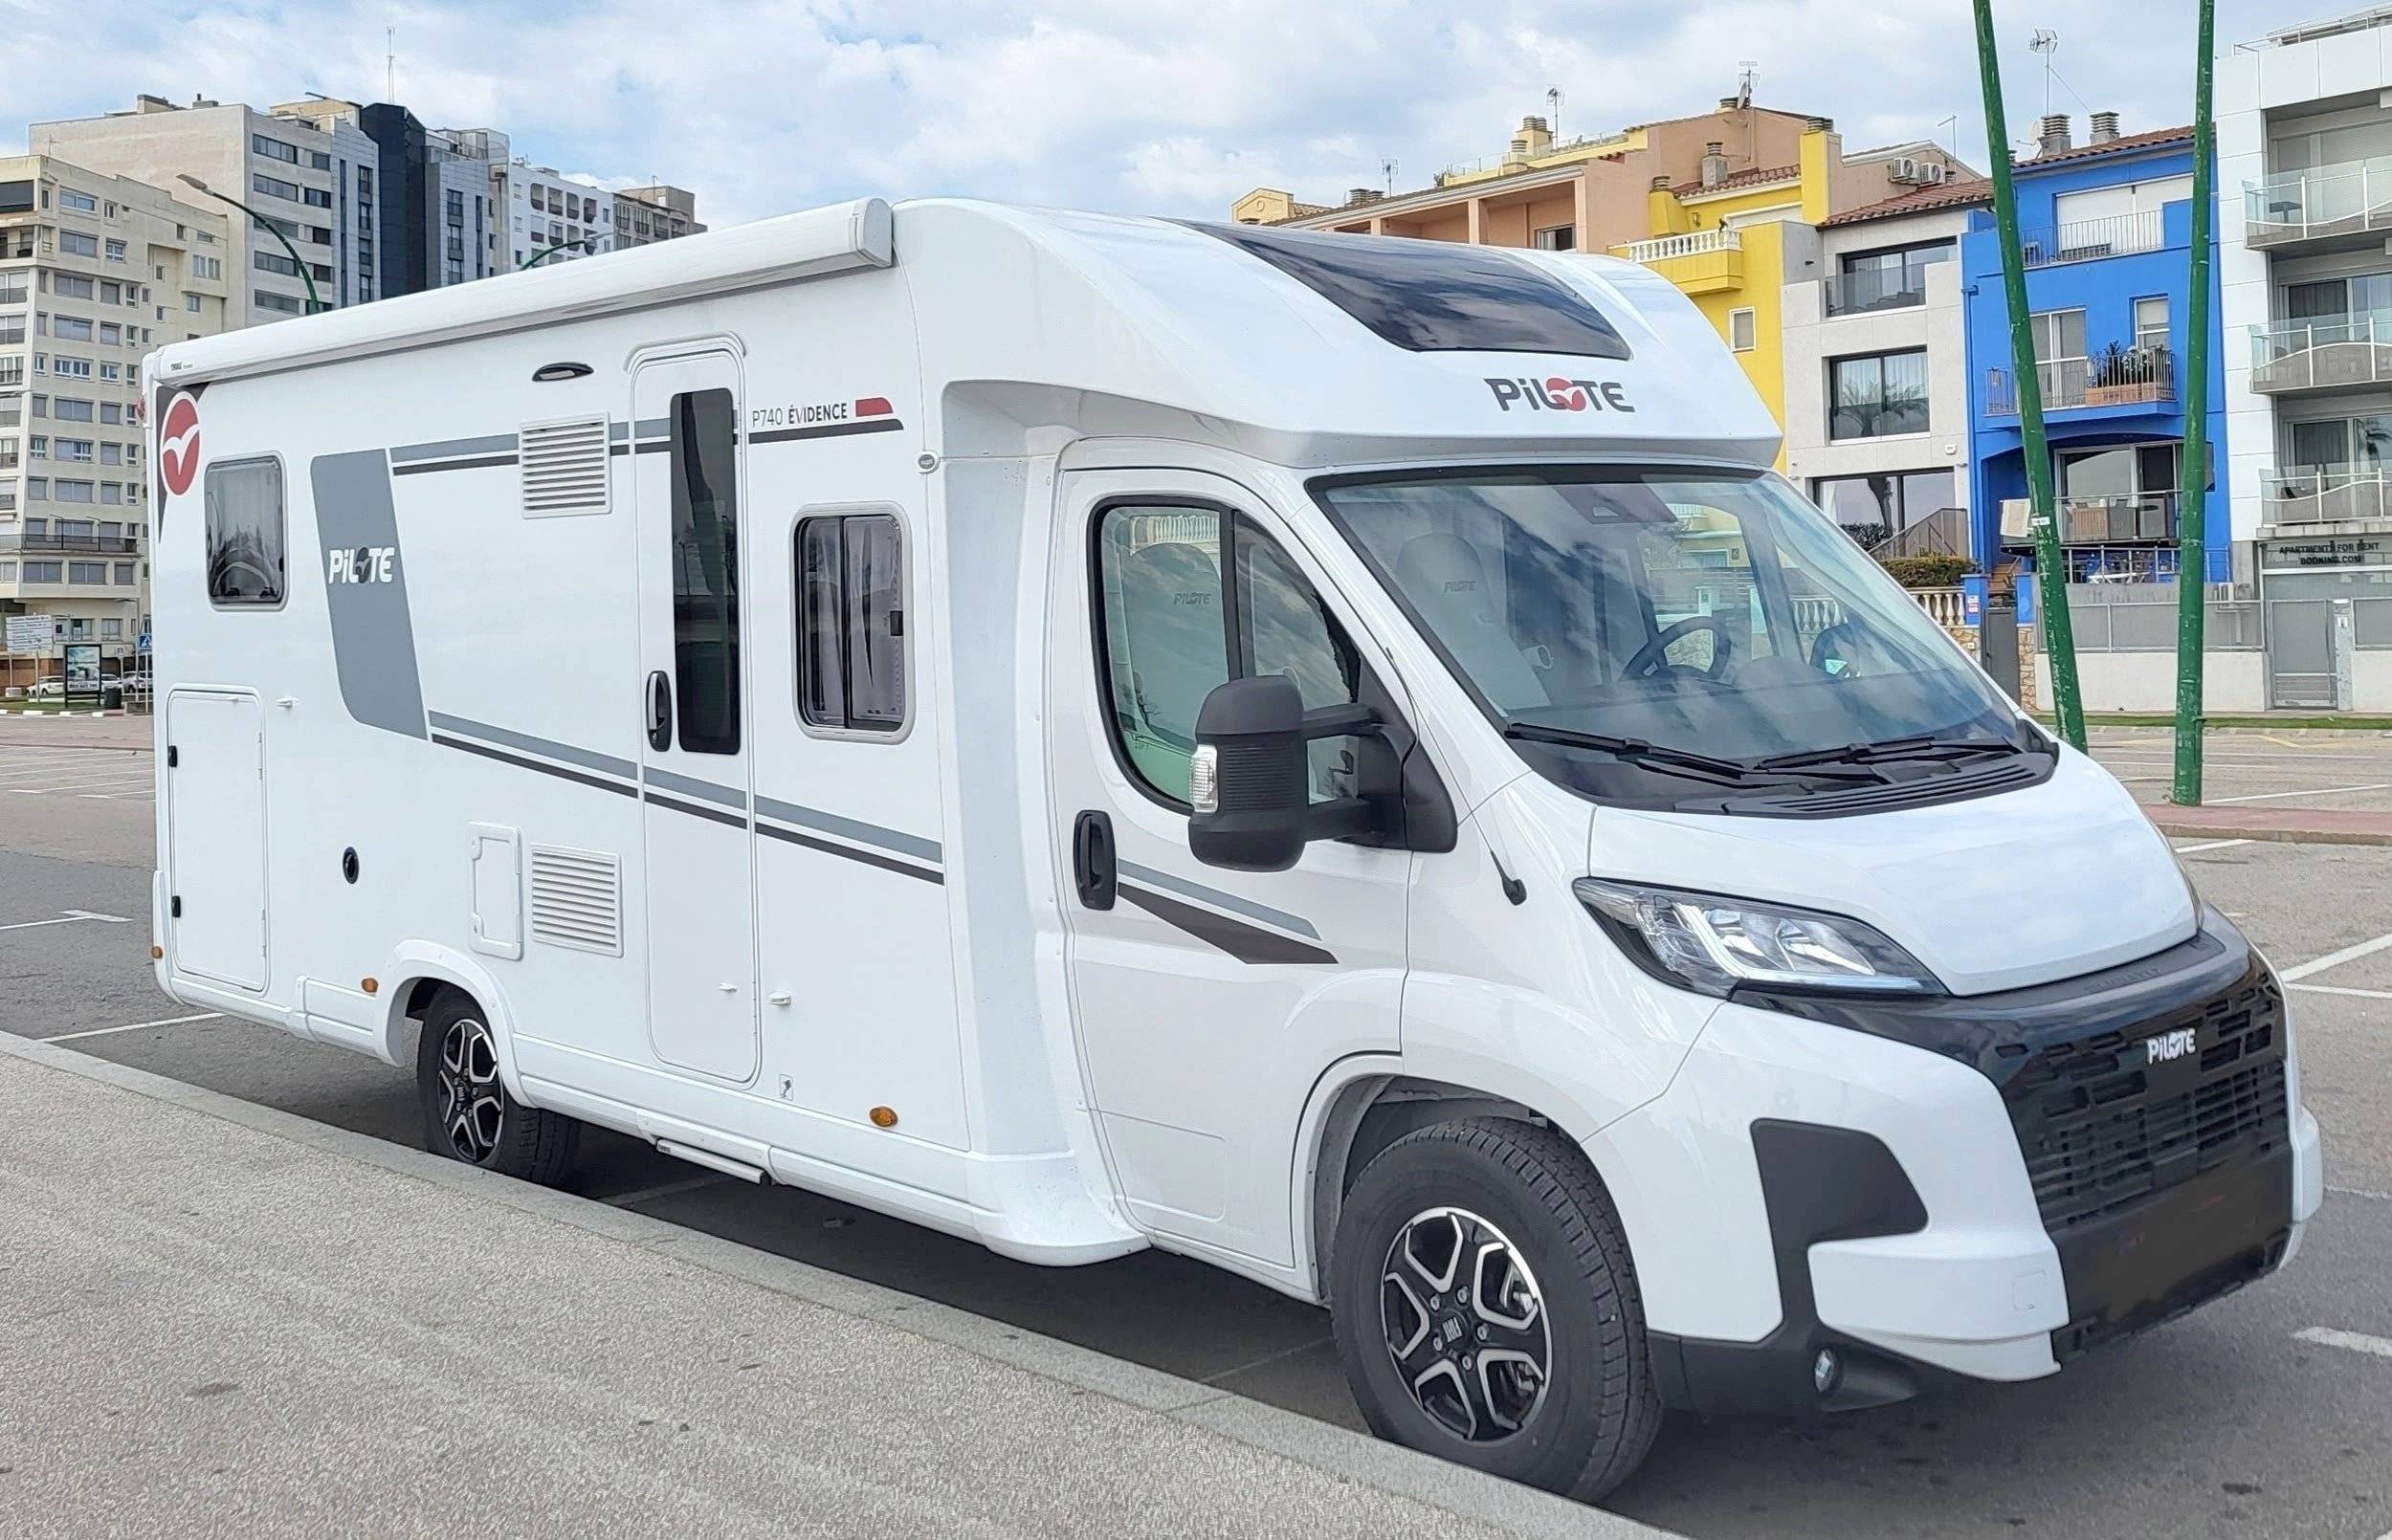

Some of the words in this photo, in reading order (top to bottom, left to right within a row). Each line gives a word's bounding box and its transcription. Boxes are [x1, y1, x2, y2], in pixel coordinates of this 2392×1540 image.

[752, 407, 783, 428] P740
[787, 403, 848, 425] ÉVIDENCE
[2337, 543, 2354, 552] FOR
